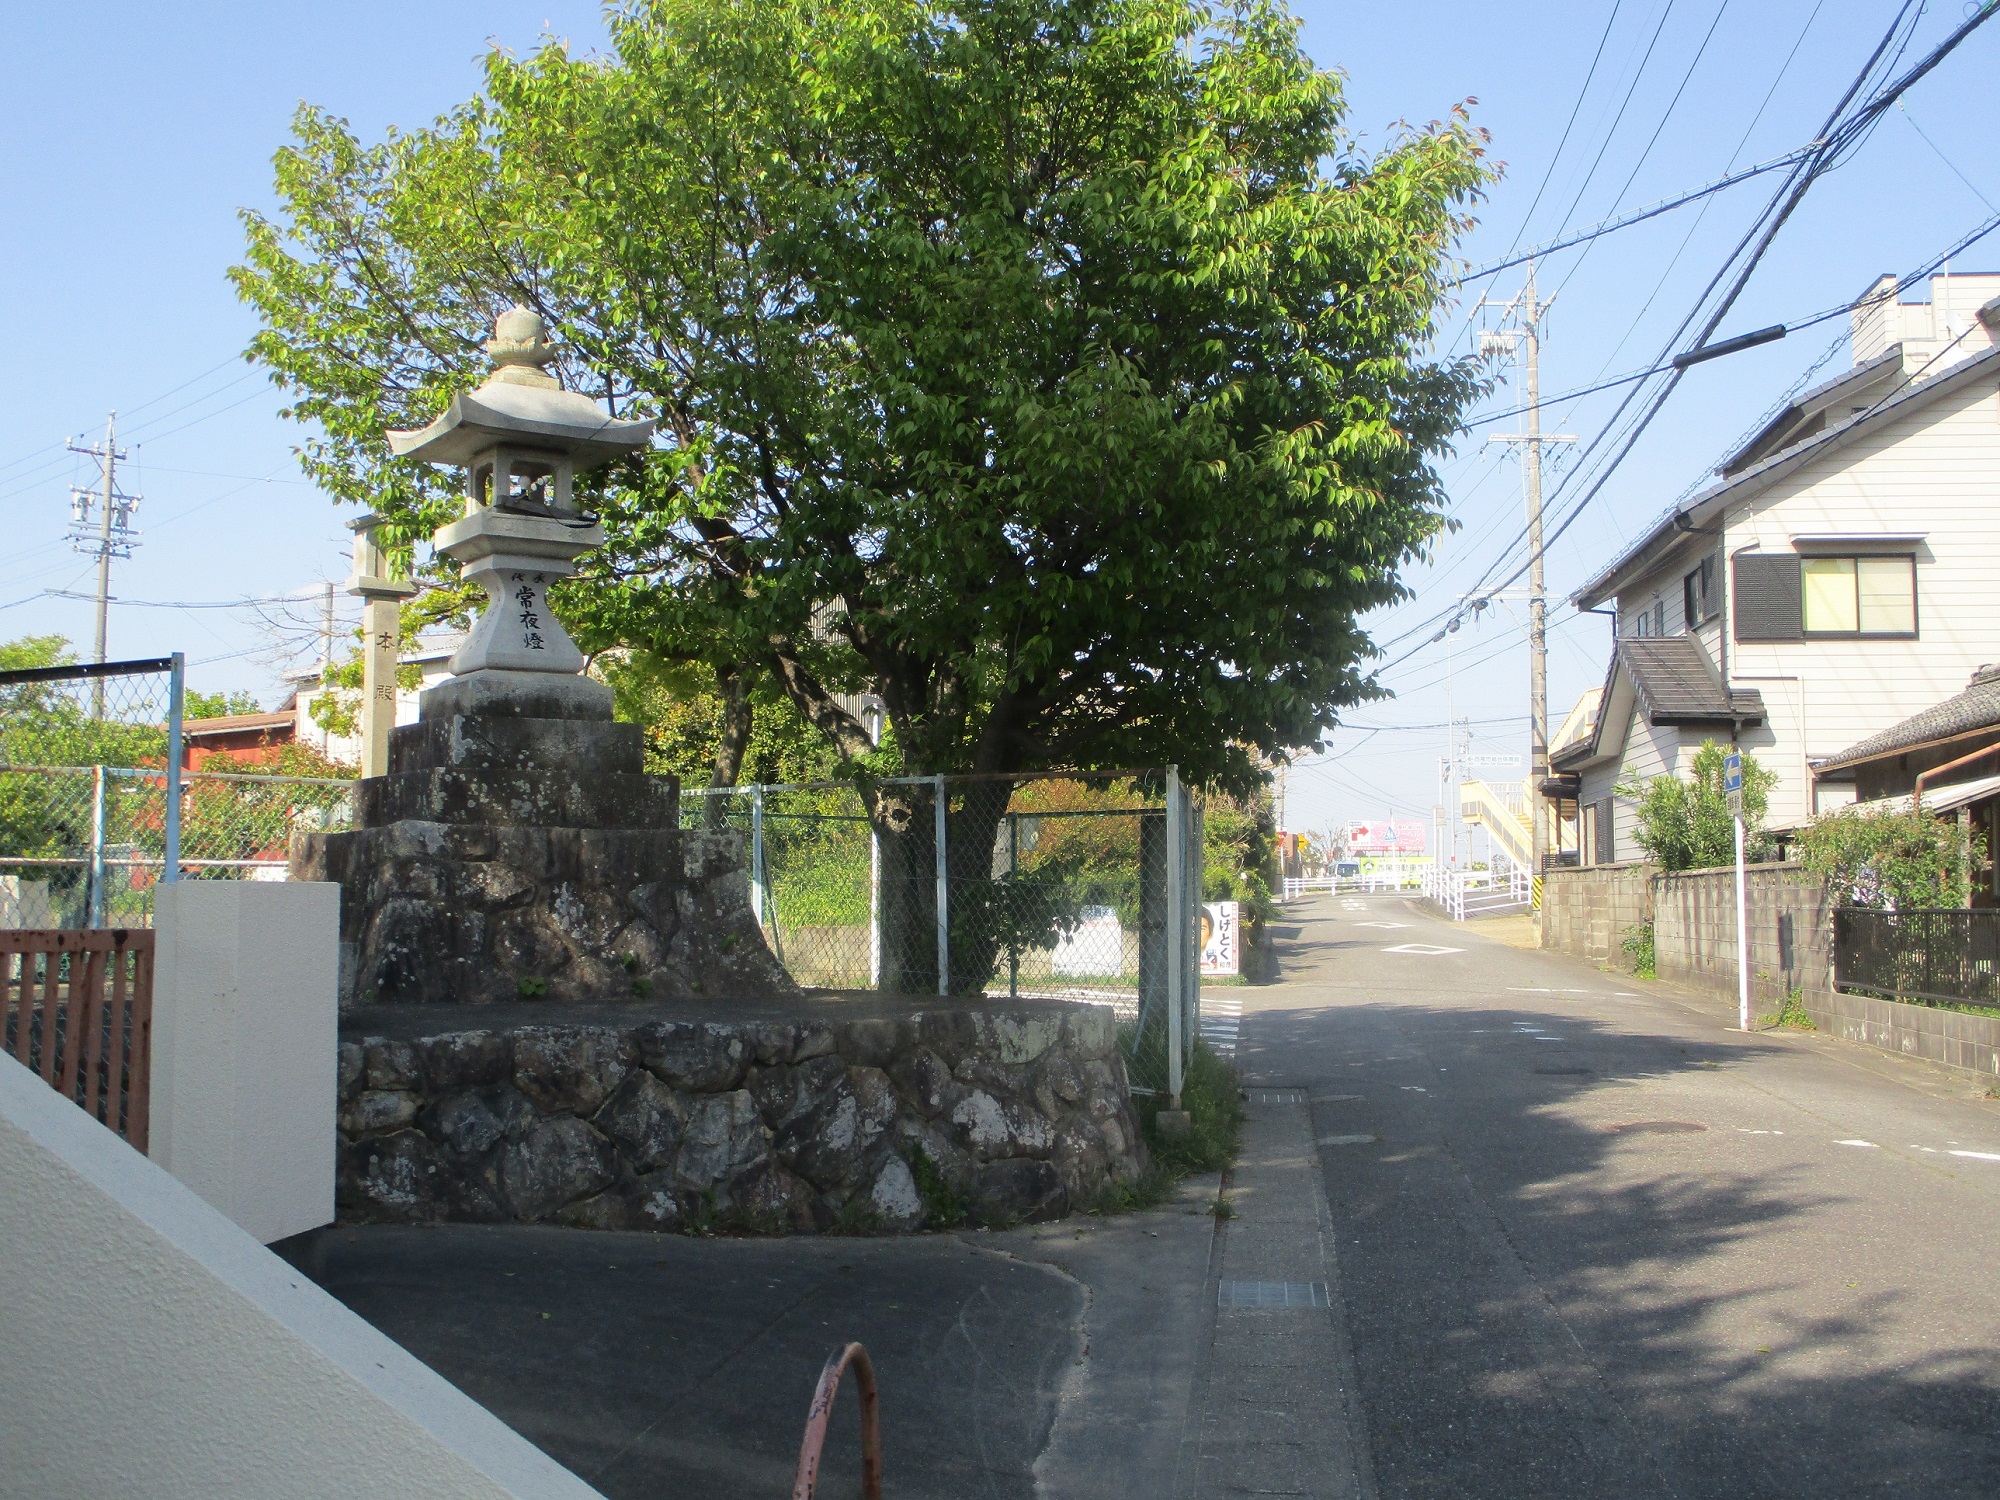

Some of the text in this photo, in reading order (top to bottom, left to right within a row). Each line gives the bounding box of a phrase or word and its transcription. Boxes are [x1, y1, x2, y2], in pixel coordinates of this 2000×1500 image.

[515, 585, 545, 650] 常夜燈
[374, 631, 395, 701] 本殿
[1219, 905, 1231, 960] しげとく
